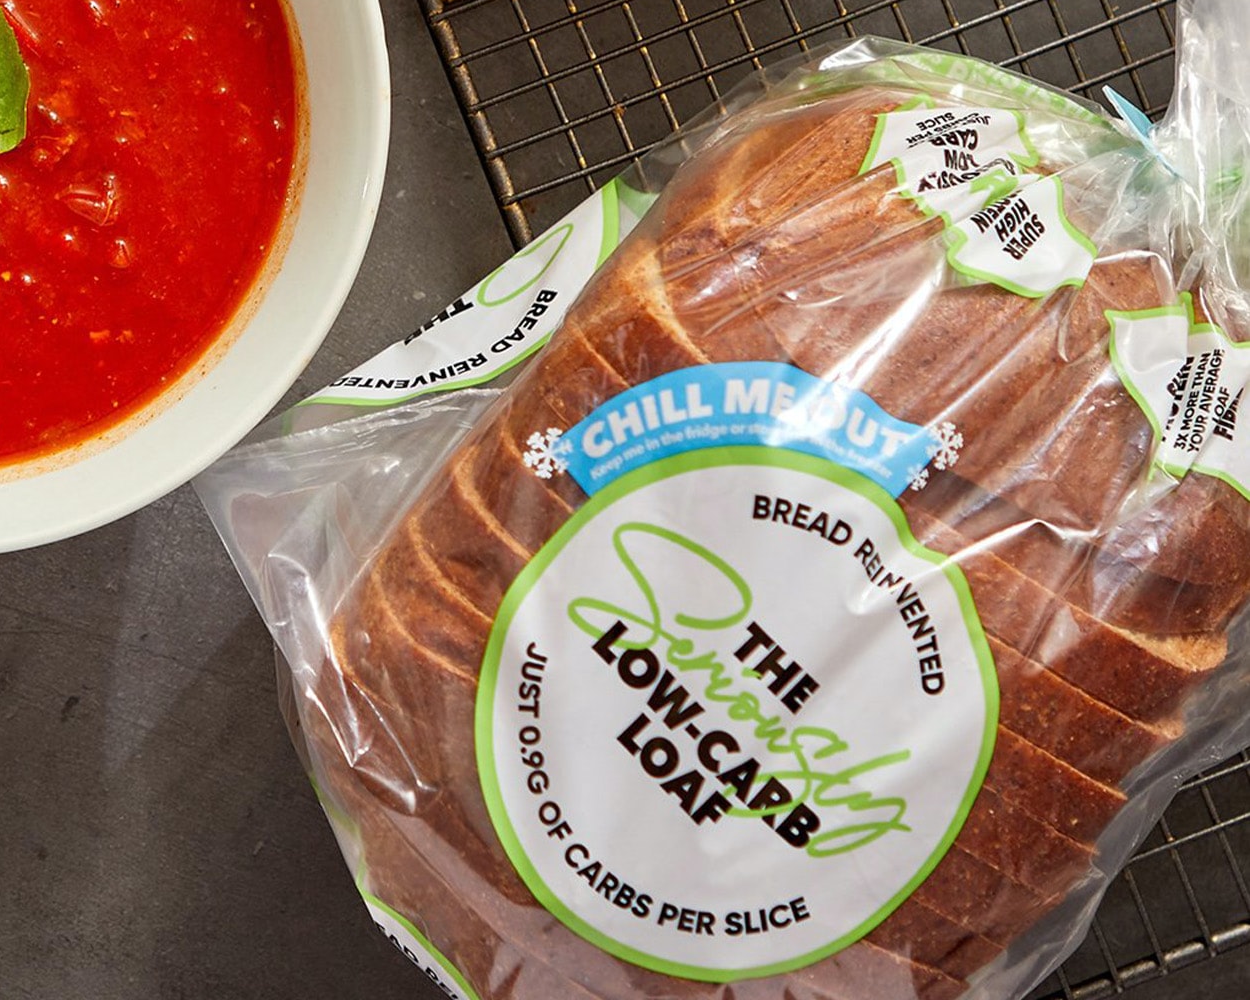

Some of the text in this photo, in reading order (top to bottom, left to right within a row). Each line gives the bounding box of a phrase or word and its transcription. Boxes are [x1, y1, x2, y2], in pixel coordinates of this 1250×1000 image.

[916, 112, 955, 131] SLICE
[994, 199, 1031, 242] HIGH
[1003, 214, 1045, 260] SUPER
[490, 289, 558, 353] BREAD
[582, 378, 912, 459] CHILL ME OUT
[1174, 353, 1211, 450] 3X MORE THAN
[1187, 349, 1223, 453] YOUR AVERAGE
[590, 454, 624, 480] Keep
[660, 430, 684, 447] the
[684, 423, 727, 440] fridge
[752, 494, 946, 696] BREAD REINVENTED
[733, 621, 820, 715] THE
[591, 620, 821, 849] LOW-CARB
[616, 712, 733, 826] LOAF
[517, 642, 811, 936] JUST 0.9G OF CARBS PER SLICE
